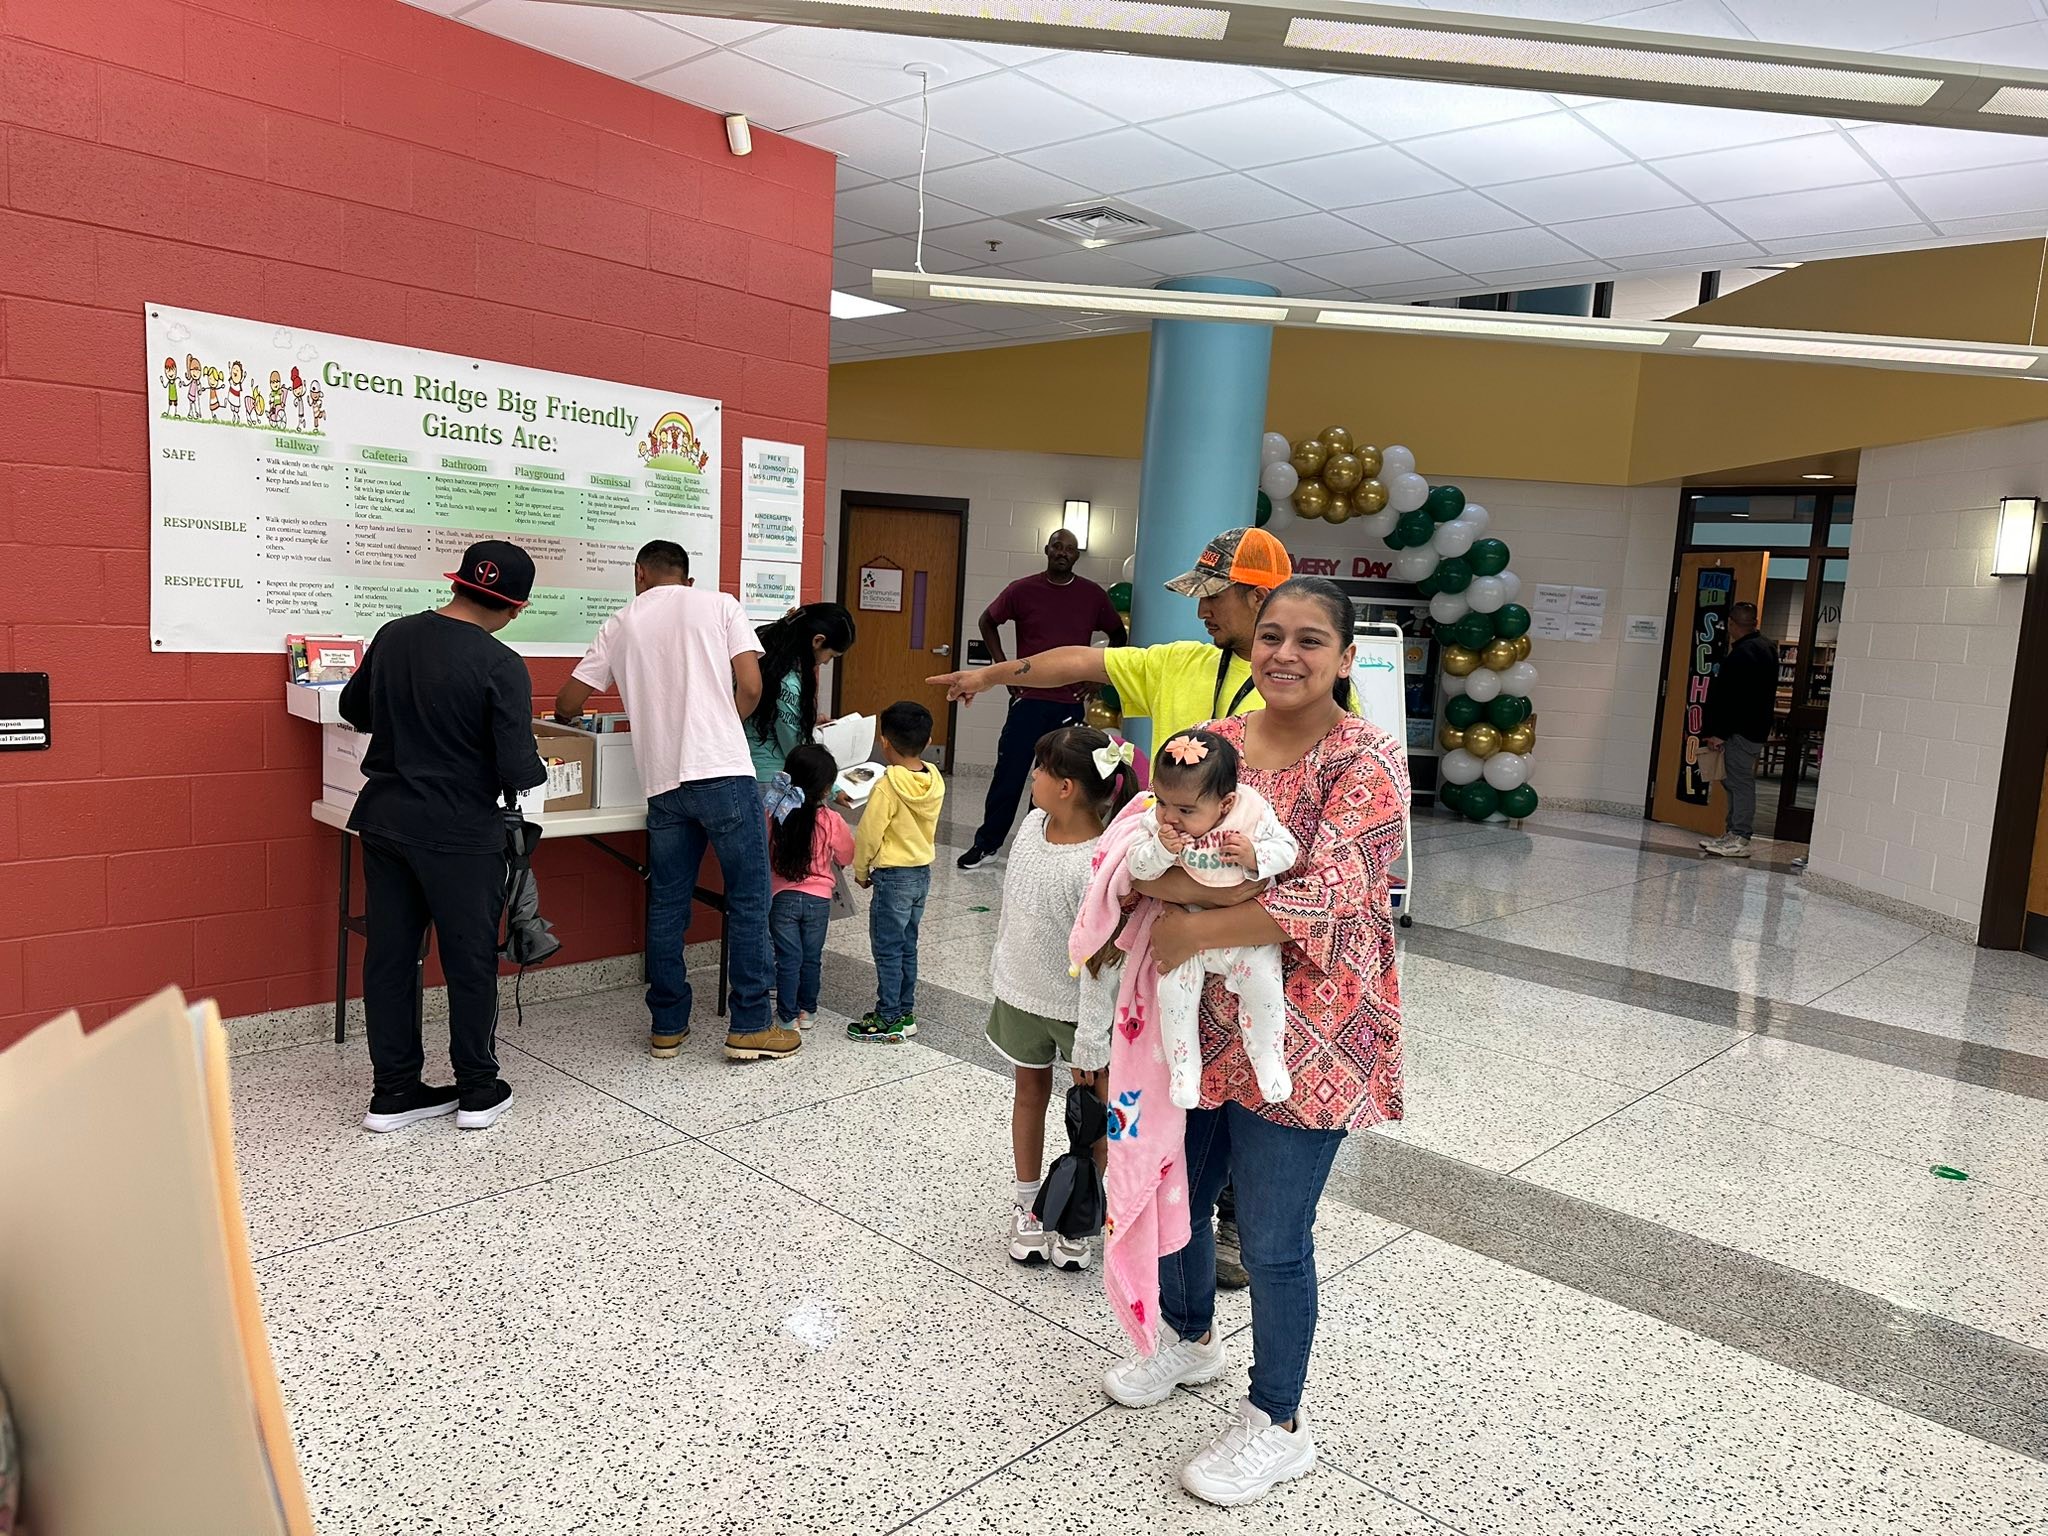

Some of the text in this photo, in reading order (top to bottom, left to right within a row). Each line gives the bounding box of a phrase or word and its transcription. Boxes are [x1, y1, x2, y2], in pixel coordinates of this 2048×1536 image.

[322, 361, 639, 437] Green Ridge Big Friendly
[422, 412, 558, 453] Giants Are:
[275, 437, 320, 454] Hallway
[162, 448, 196, 461] SAFE
[361, 448, 408, 463] Cafeteria
[441, 458, 487, 472] Bathroom
[514, 466, 565, 480] Playground
[655, 472, 682, 484] Working
[266, 477, 280, 485] Keep
[590, 474, 631, 488] Dismissal
[655, 489, 685, 500] Computer
[163, 516, 247, 533] RESPONSIBLE
[755, 513, 791, 522] KINDERGARTEN
[1352, 557, 1392, 578] DAY
[164, 575, 244, 589] RESPECTFUL
[1686, 612, 1718, 795] SCHOOL
